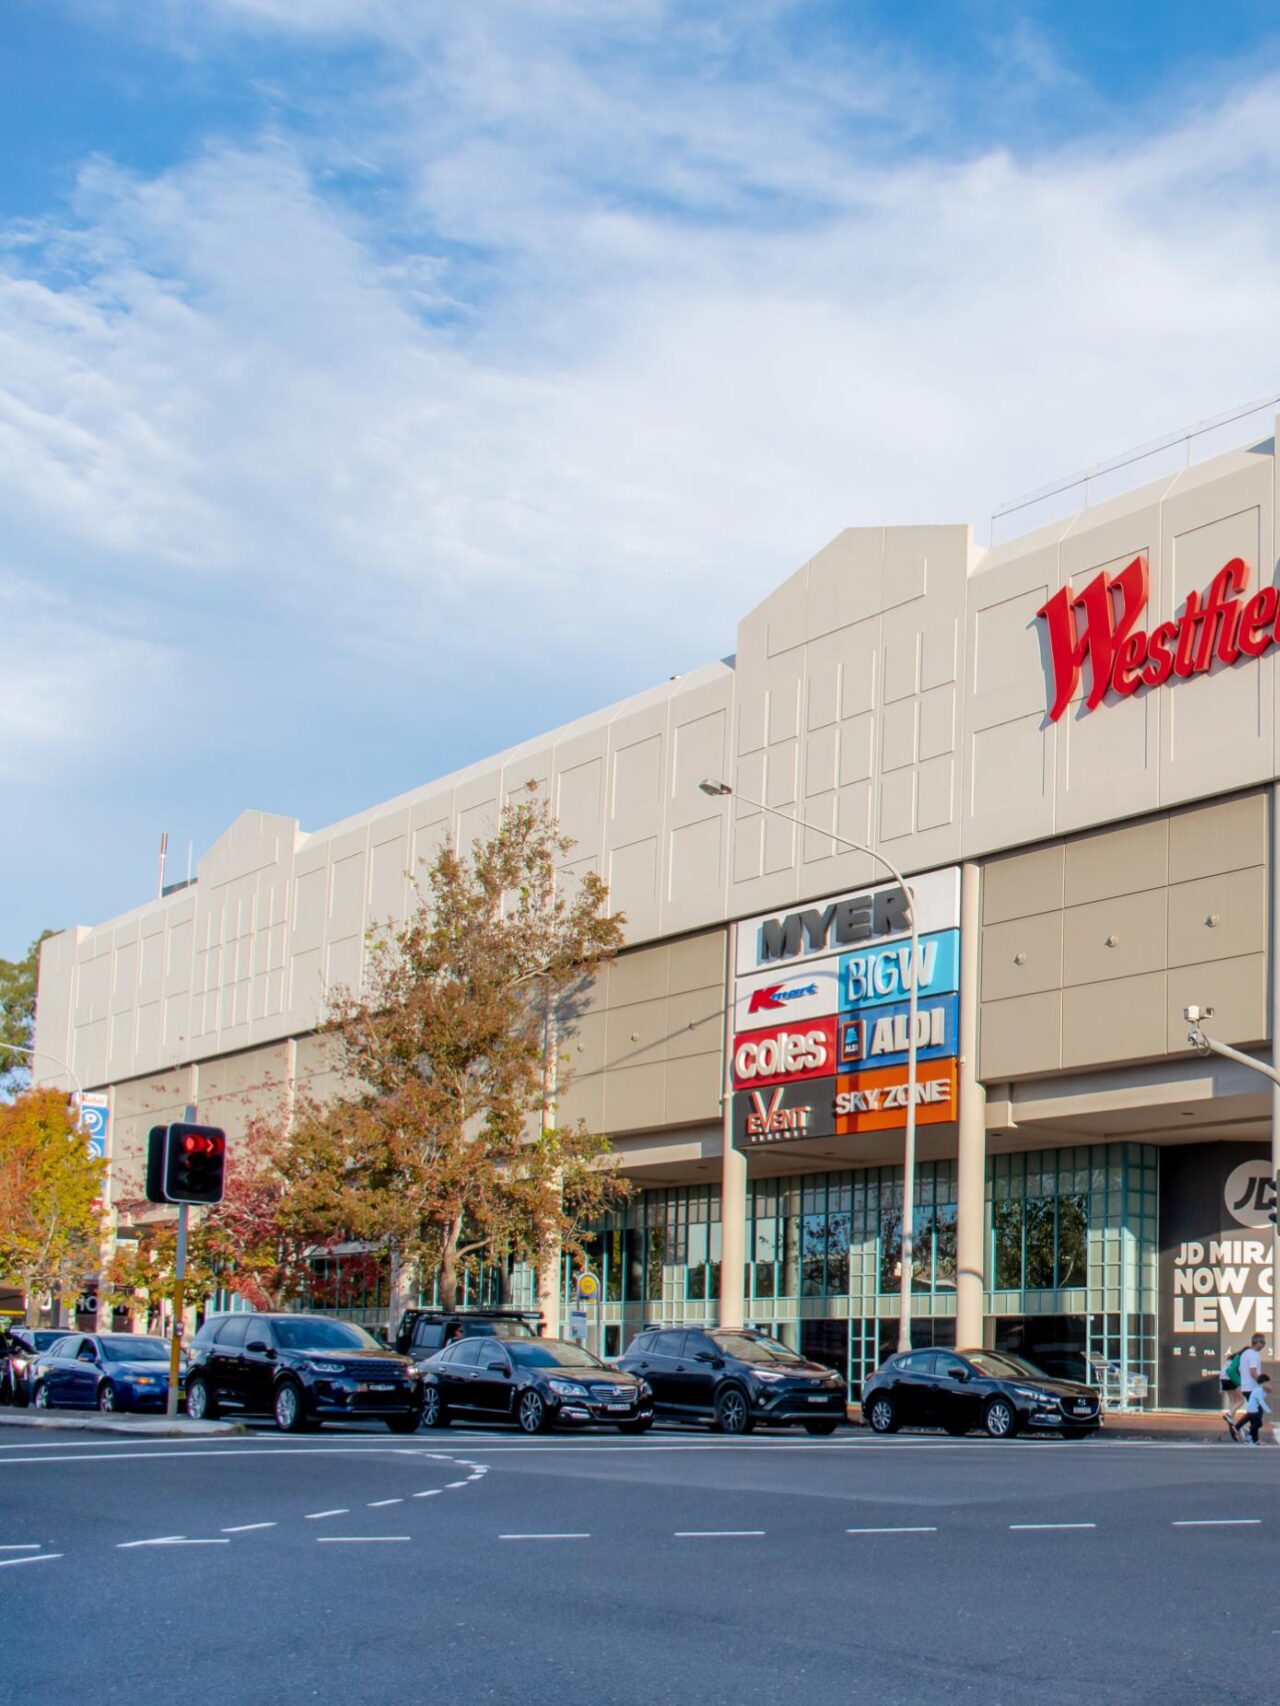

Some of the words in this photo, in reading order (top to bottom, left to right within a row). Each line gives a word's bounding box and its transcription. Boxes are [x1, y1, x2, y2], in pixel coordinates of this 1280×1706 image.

[761, 887, 914, 960] MYER
[748, 983, 819, 1014] Kmart
[871, 1007, 945, 1055] ALDI
[747, 1087, 811, 1134] EVENT
[836, 1090, 880, 1115] SKY
[883, 1078, 951, 1108] ZONE
[1233, 1176, 1276, 1211] JD
[1174, 1241, 1204, 1266] JD
[1174, 1267, 1250, 1294] NOW
